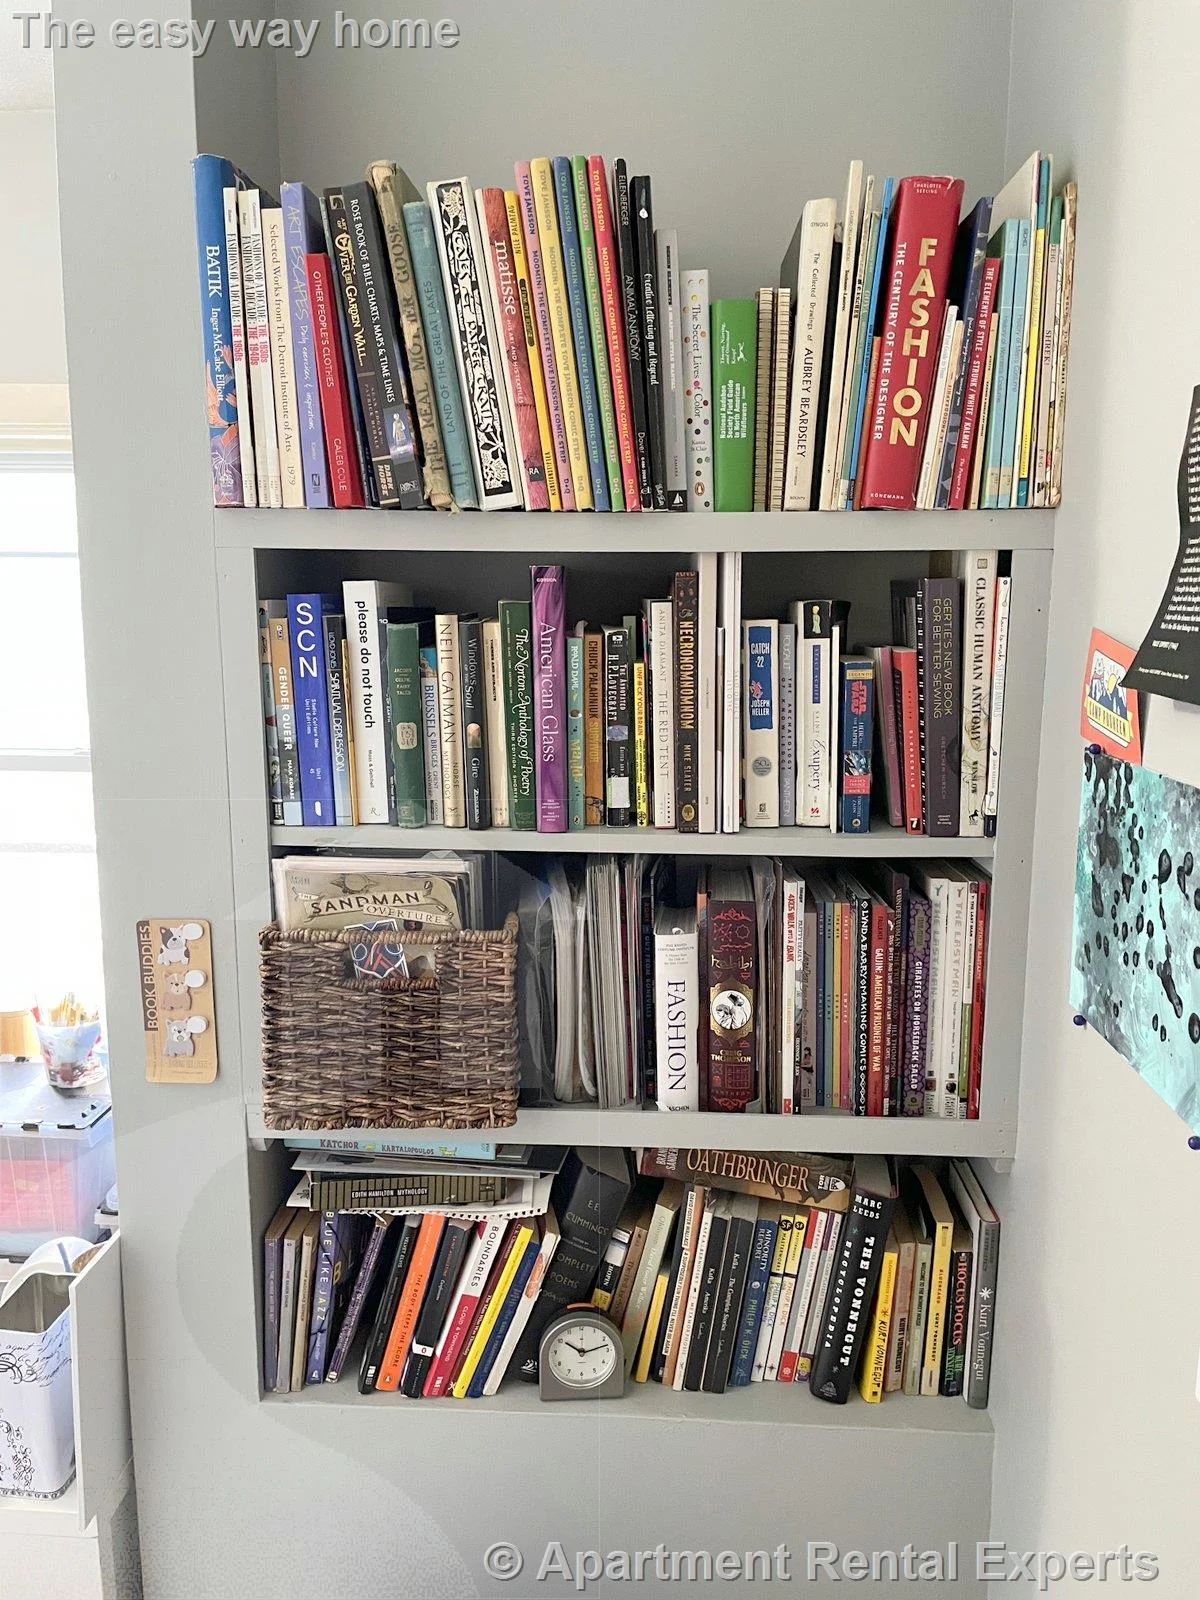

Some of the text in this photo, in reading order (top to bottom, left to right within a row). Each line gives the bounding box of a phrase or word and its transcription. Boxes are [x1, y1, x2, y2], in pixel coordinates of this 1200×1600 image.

[350, 199, 362, 222] ROSE
[355, 224, 367, 248] BOOK
[359, 250, 369, 262] OF
[361, 263, 373, 288] BIBLE
[495, 241, 516, 316] matisse
[205, 245, 226, 402] BATIK Inger McCabe Elliott
[373, 323, 385, 347] MAPS
[691, 304, 702, 379] The Secret Lives
[873, 242, 908, 440] THE CENTURY OF THE DESIGNER
[889, 237, 939, 447] FASHION
[269, 224, 296, 485] Selected Works from The Detroit Institute of Arts 1979
[377, 348, 386, 358] &
[379, 357, 390, 377] TIME
[423, 281, 456, 434] LAND OF THE GREAT LAKES
[796, 252, 821, 458] The Collected Drawings of AUBREY BEARDSLEY
[960, 267, 996, 450] THE ELEMENTS OF STYLE STRUNK WHITE KALMAN
[313, 271, 325, 302] OTHER
[322, 347, 335, 387] CLOTHES
[333, 438, 343, 467] CALEB
[338, 468, 347, 491] COLE
[384, 377, 396, 404] LINES
[870, 492, 905, 501] KÖNEMANN
[974, 577, 987, 630] CLASSIC
[296, 602, 318, 678] SCN
[467, 638, 478, 686] Windows
[750, 642, 770, 655] CATCH
[932, 598, 943, 719] FOR BETTER SEWING
[942, 597, 953, 716] GERTIE'S NEW BOOK
[972, 633, 985, 681] HUMAN
[278, 666, 290, 710] GENDER
[355, 600, 377, 729] please do not touch
[439, 623, 456, 743] NEIL GAIMAN
[571, 645, 580, 691] ROALD DAHL
[588, 640, 599, 719] CHUCK PALAHNIUK
[465, 684, 476, 709] Soul
[513, 629, 534, 797] The Norton Anthology of Poetry
[540, 622, 559, 762] American Glass
[659, 609, 669, 779] ANITA DIAMANT THE RED TENT
[750, 699, 771, 708] JOSEPH
[751, 707, 770, 716] HELLER
[970, 685, 984, 741] ANATOMY
[1089, 700, 1102, 721] CAMP
[282, 713, 293, 751] QUEER
[424, 685, 439, 769] BRUSSELS BRUGES
[452, 762, 461, 789] NORSE
[471, 757, 481, 780] Gire
[684, 744, 692, 792] MIKE SLATER
[311, 891, 420, 914] SANDMAN
[366, 905, 442, 925] OVERTURE
[139, 924, 159, 1031] BOOK BUDDIES
[860, 909, 868, 1072] LYNDA BARRY MAKING COMICS
[668, 979, 687, 1091] FASHION
[910, 961, 923, 1090] GIRAFFES ON HORSEBACK SALAD
[320, 1139, 359, 1150] KATCHOR
[351, 1187, 429, 1198] EDITH HAMILTON MYTHOLOGY
[686, 1148, 809, 1192] OATHBRINGER
[565, 1211, 610, 1237] CUMMINGS
[781, 1220, 793, 1230] SF
[852, 1205, 881, 1220] LEEDS
[854, 1194, 883, 1210] MARC
[316, 1210, 335, 1322] BLUE LIKE JAZZ
[471, 1226, 499, 1288] BOUNDARIES
[753, 1228, 766, 1260] REPORT
[757, 1229, 773, 1273] MINORITY
[550, 1272, 580, 1289] POEMS
[823, 1240, 854, 1349] ENCYCLOPEDIA
[839, 1236, 876, 1368] THE VONNEGUT
[952, 1260, 968, 1346] HOCUS POCUS
[871, 1320, 888, 1392] KURT VONNEGUT
[973, 1303, 991, 1382] Kurt Vonnegut
